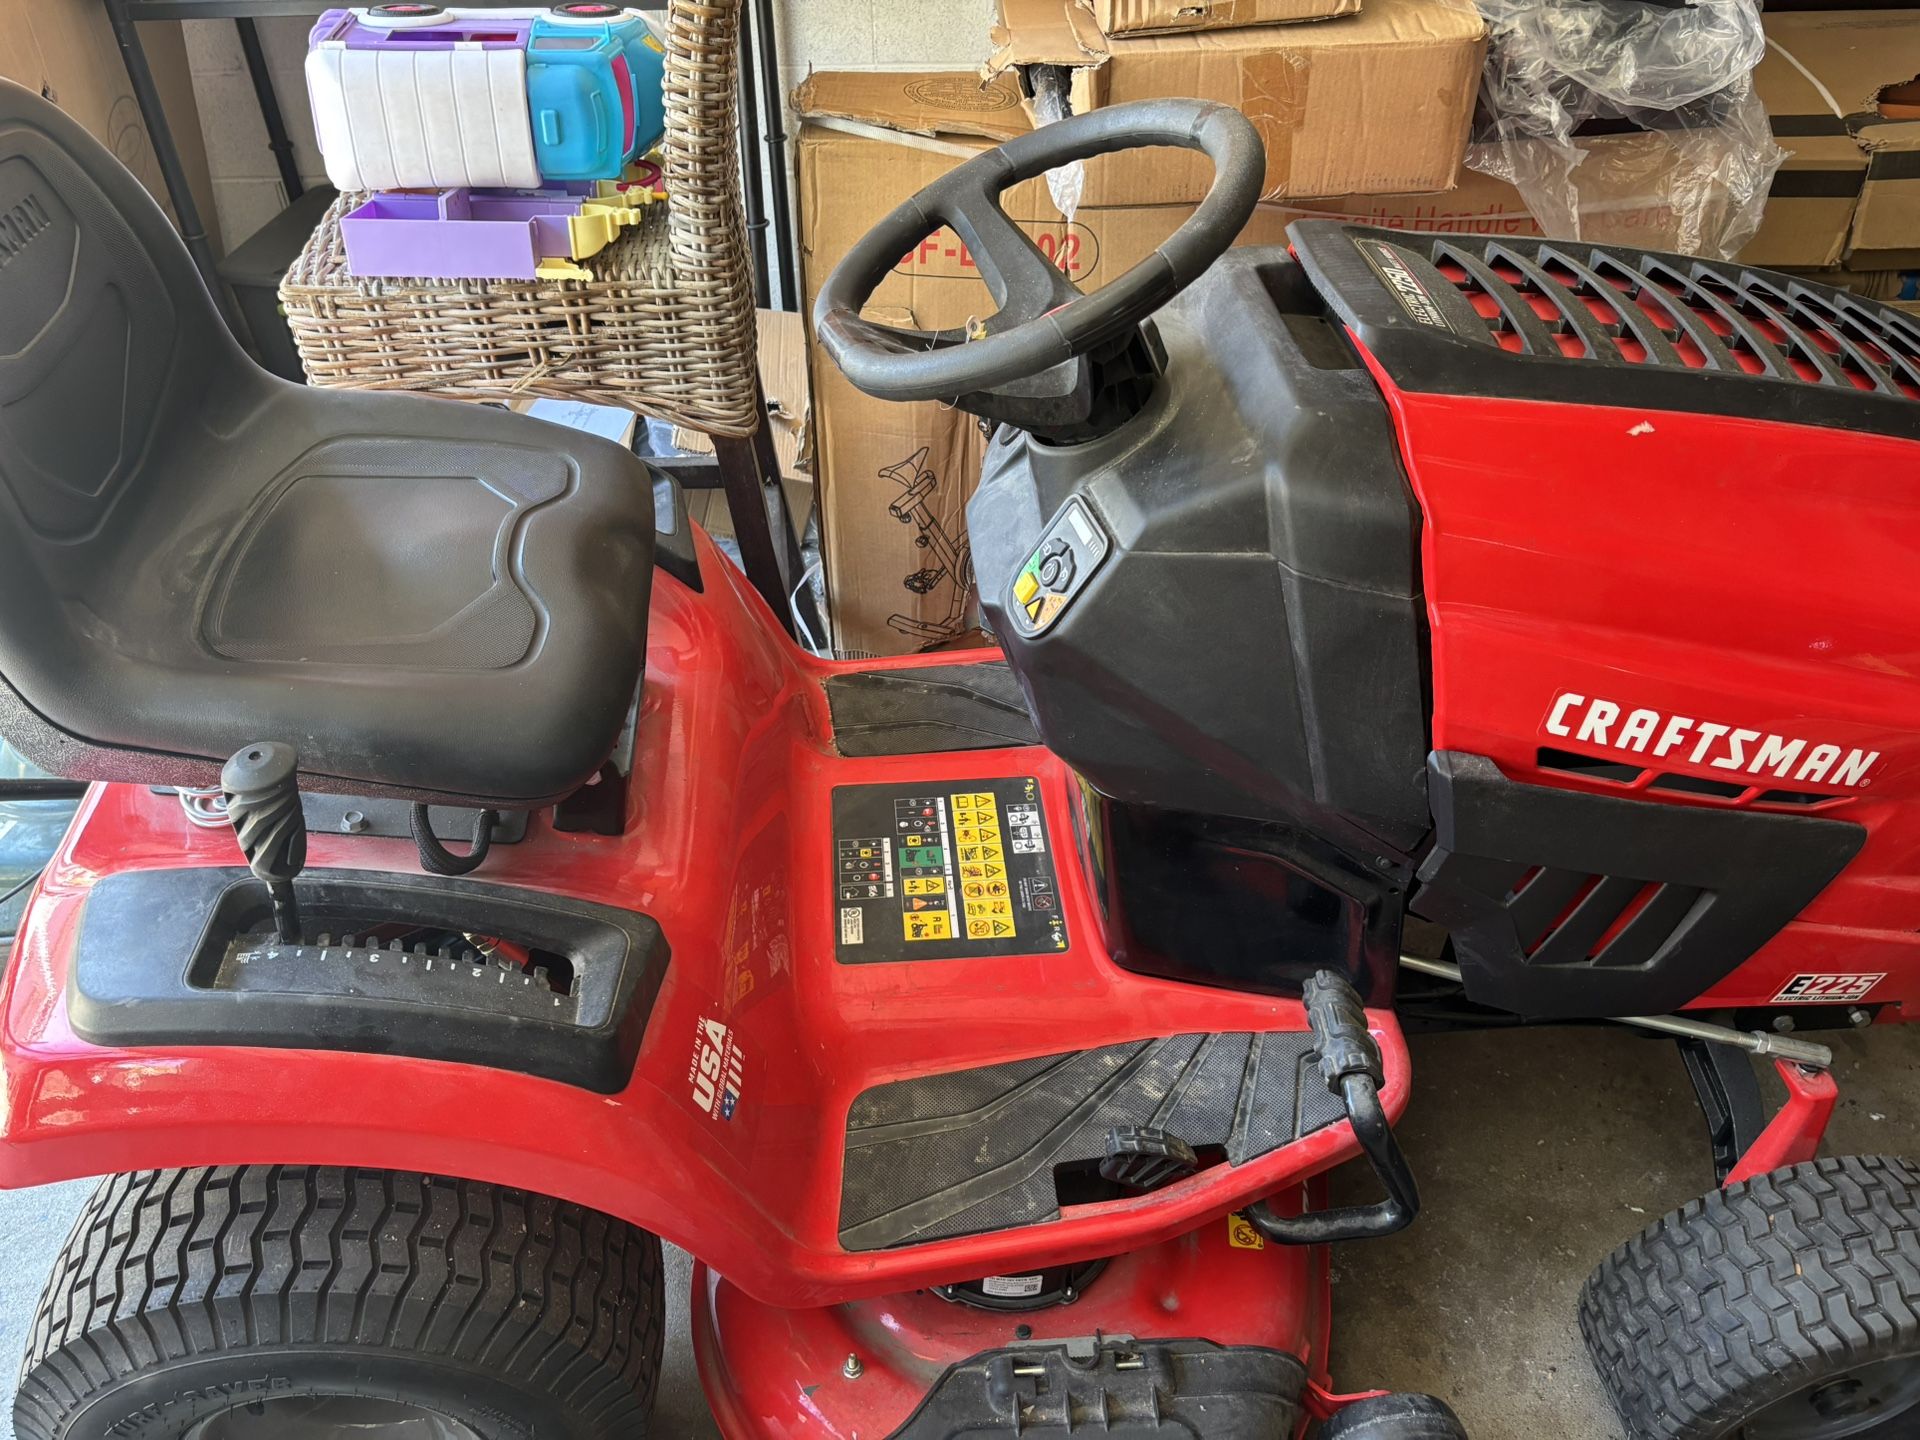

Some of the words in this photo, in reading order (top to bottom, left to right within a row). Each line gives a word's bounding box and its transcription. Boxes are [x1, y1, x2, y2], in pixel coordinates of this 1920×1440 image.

[0, 193, 51, 272] MAN
[1414, 203, 1520, 234] Handle
[1545, 692, 1881, 788] CRAFTSMAN
[472, 967, 482, 977] 2
[1781, 975, 1880, 995] E225
[696, 1014, 706, 1036] THE
[694, 1036, 702, 1051] IN
[688, 1051, 700, 1084] MADE
[692, 1018, 727, 1113] USA
[711, 1097, 721, 1121] WITH
[716, 1073, 727, 1098] GLOBAL
[722, 1028, 734, 1073] MATERIALS
